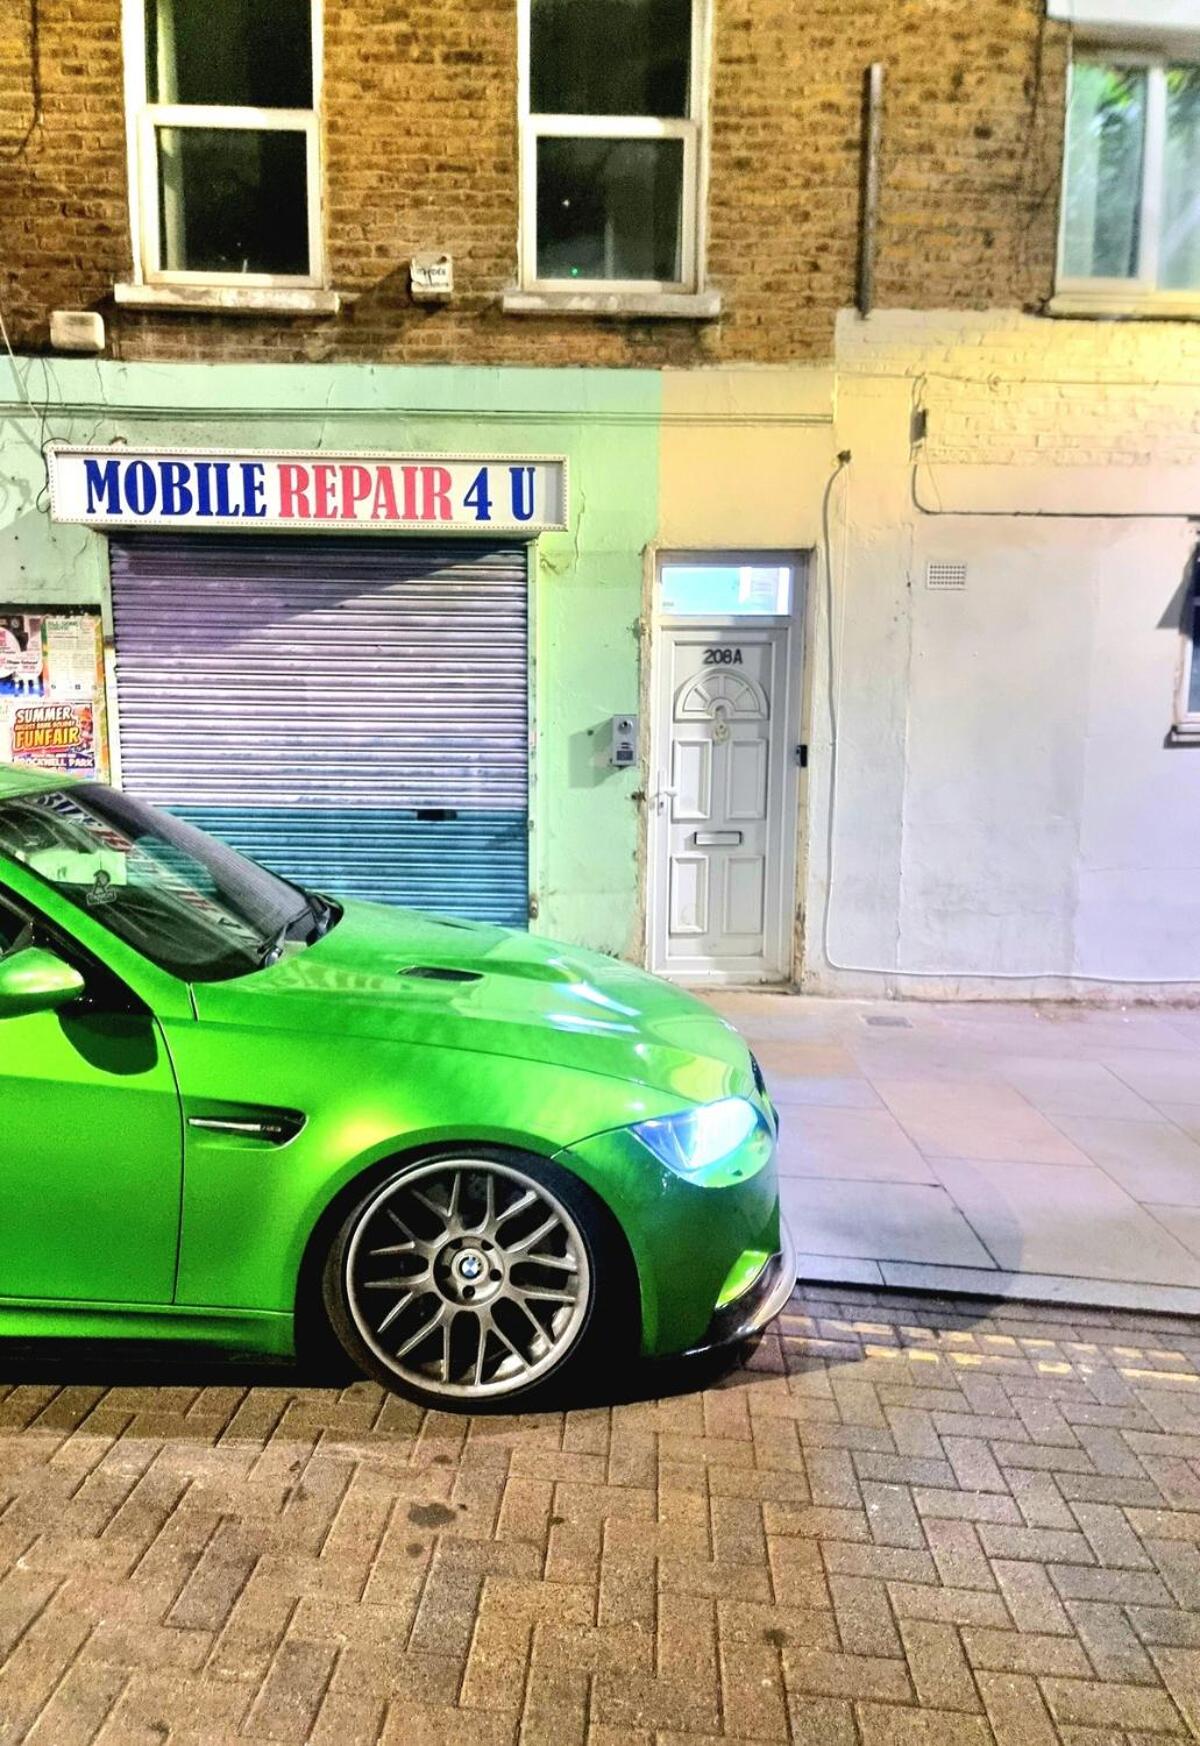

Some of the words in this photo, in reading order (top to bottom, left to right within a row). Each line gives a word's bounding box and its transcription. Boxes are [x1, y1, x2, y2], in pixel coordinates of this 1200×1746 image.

[84, 459, 266, 517] MOBILE
[277, 464, 453, 520] REPAIR
[463, 467, 492, 521] 4
[509, 467, 536, 521] U
[702, 648, 743, 665] 208A
[15, 706, 72, 723] SUMMER
[15, 727, 80, 748] FUNFAIR
